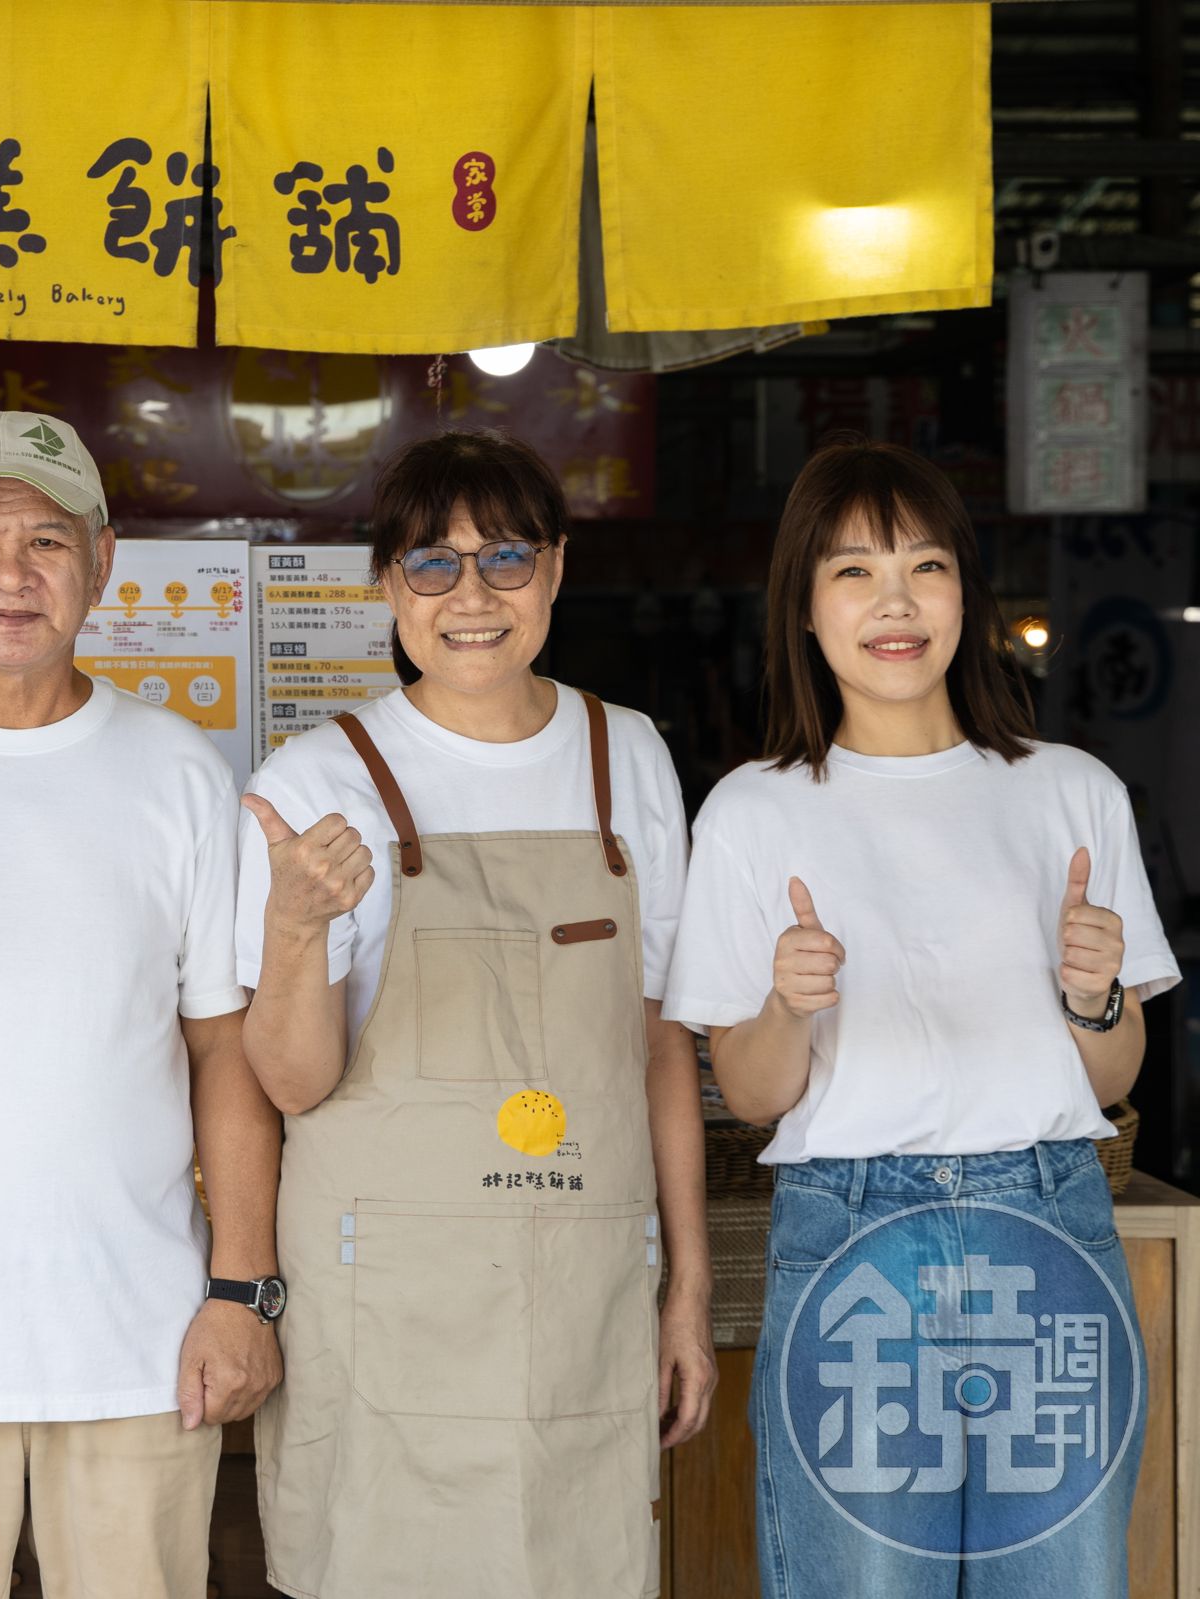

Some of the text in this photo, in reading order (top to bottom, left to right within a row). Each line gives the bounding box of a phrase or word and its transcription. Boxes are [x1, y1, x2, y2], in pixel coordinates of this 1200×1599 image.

[463, 158, 488, 224] 家常
[52, 284, 125, 316] Bakery
[119, 587, 141, 595] 8/19
[166, 587, 187, 595] 8/25
[211, 587, 233, 595] 9/17
[143, 682, 166, 691] 9/10
[193, 682, 216, 691] 9/11
[482, 1171, 585, 1191] 林記糕餅舖
